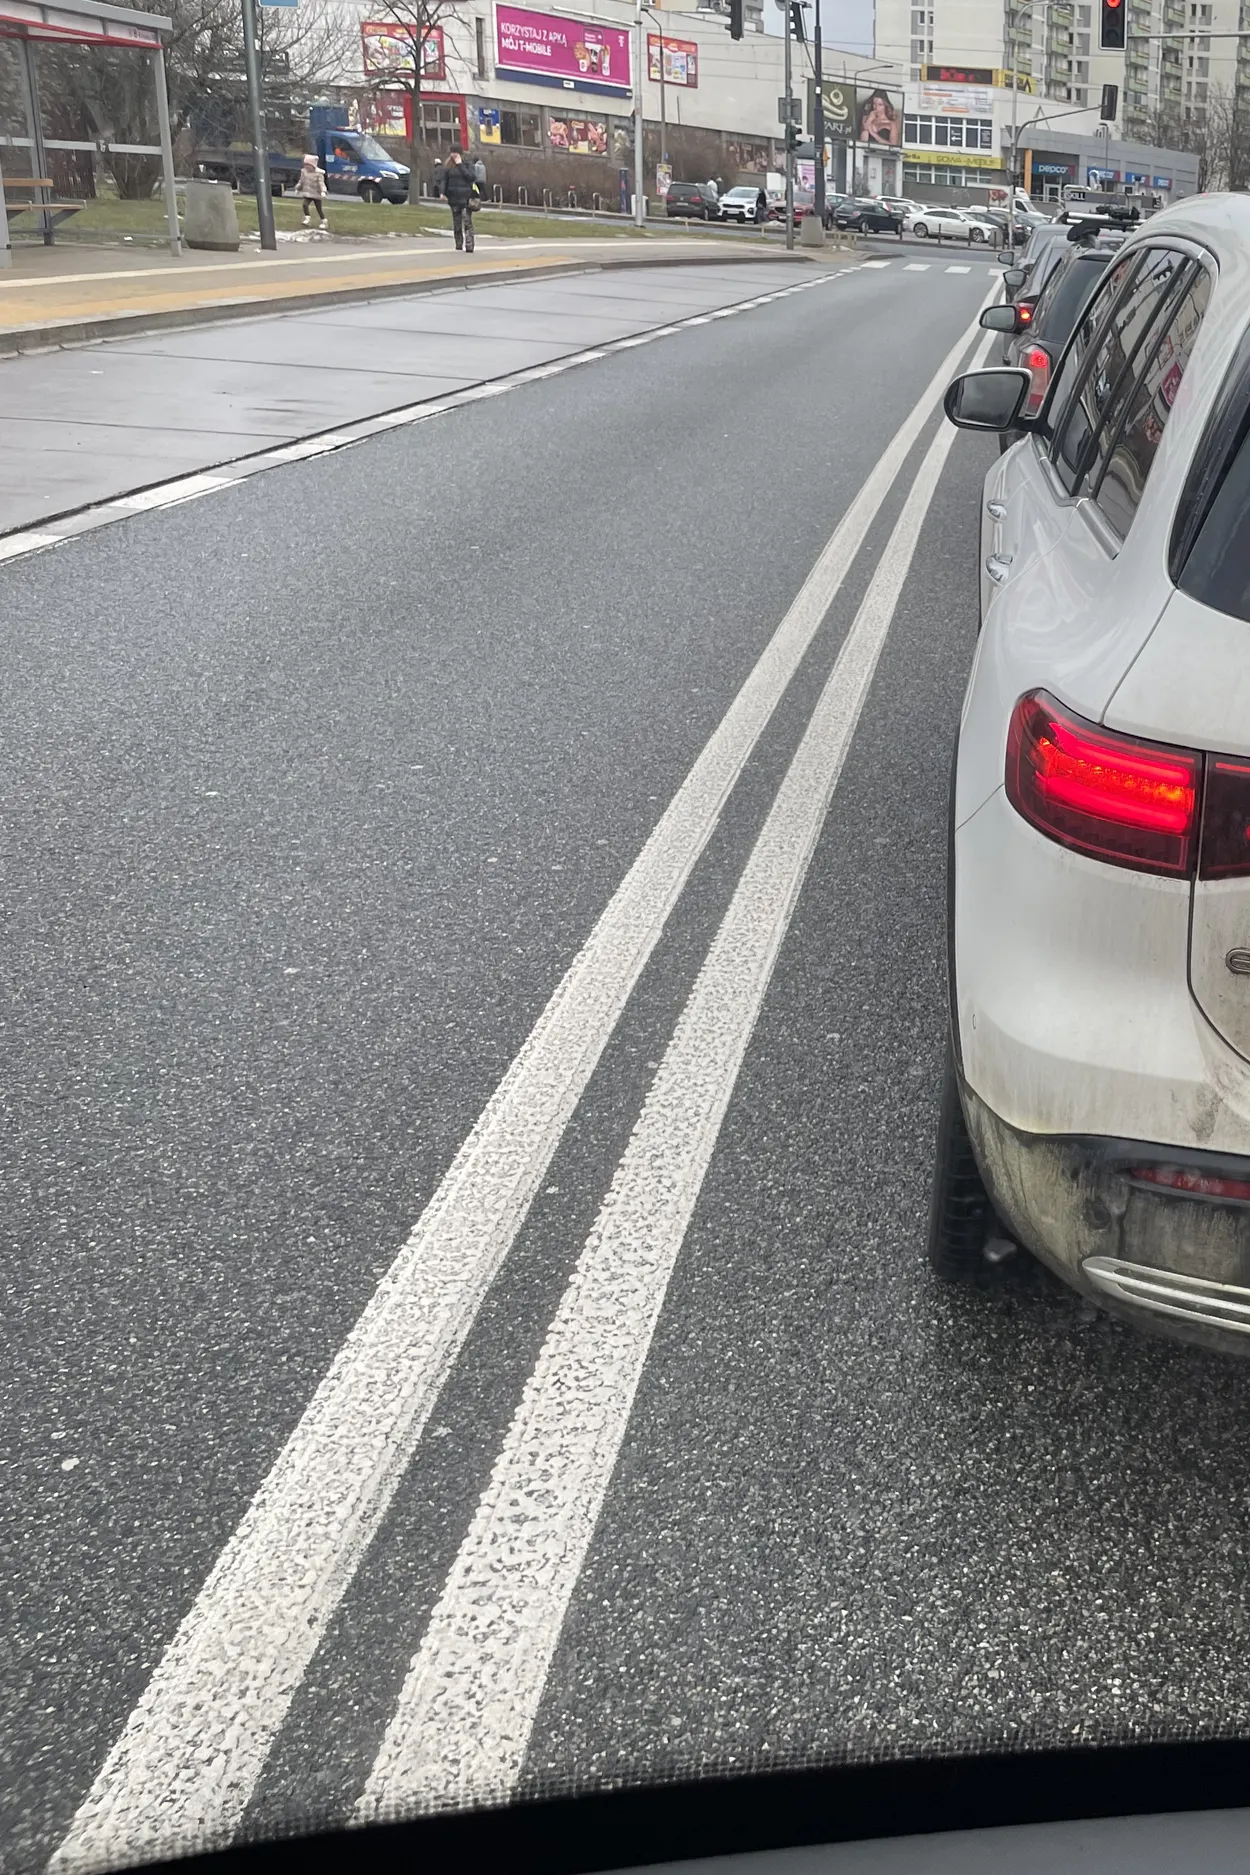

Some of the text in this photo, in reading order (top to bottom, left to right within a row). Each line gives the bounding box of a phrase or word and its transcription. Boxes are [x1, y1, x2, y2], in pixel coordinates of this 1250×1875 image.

[501, 22, 541, 40] KORZYSTAJ
[543, 29, 547, 40] Z
[548, 32, 567, 47] APKĄ
[502, 36, 552, 56] MÓJ T-MOBILE
[1038, 164, 1067, 173] pepco
